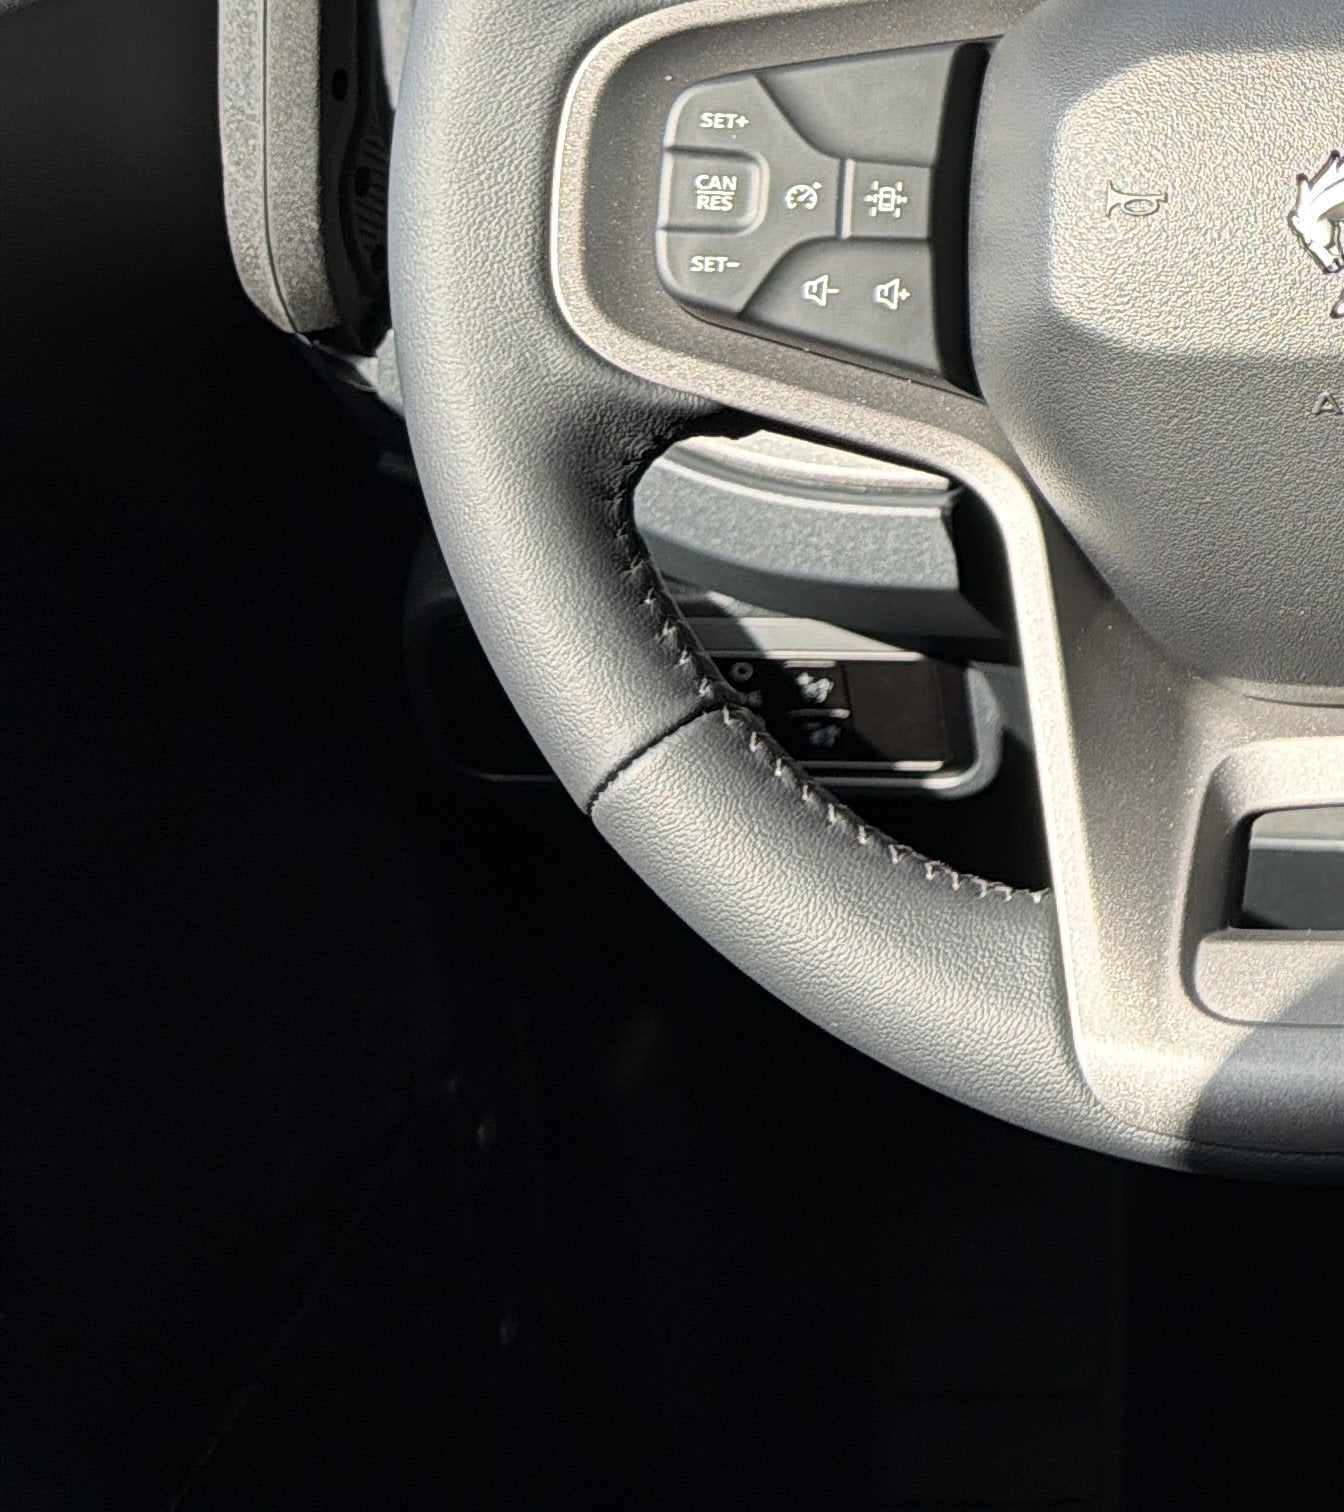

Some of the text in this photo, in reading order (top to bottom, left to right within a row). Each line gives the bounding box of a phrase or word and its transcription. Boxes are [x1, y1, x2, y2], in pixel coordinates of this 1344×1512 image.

[700, 112, 749, 129] SET+
[695, 174, 738, 190] CAN
[696, 195, 734, 212] RES
